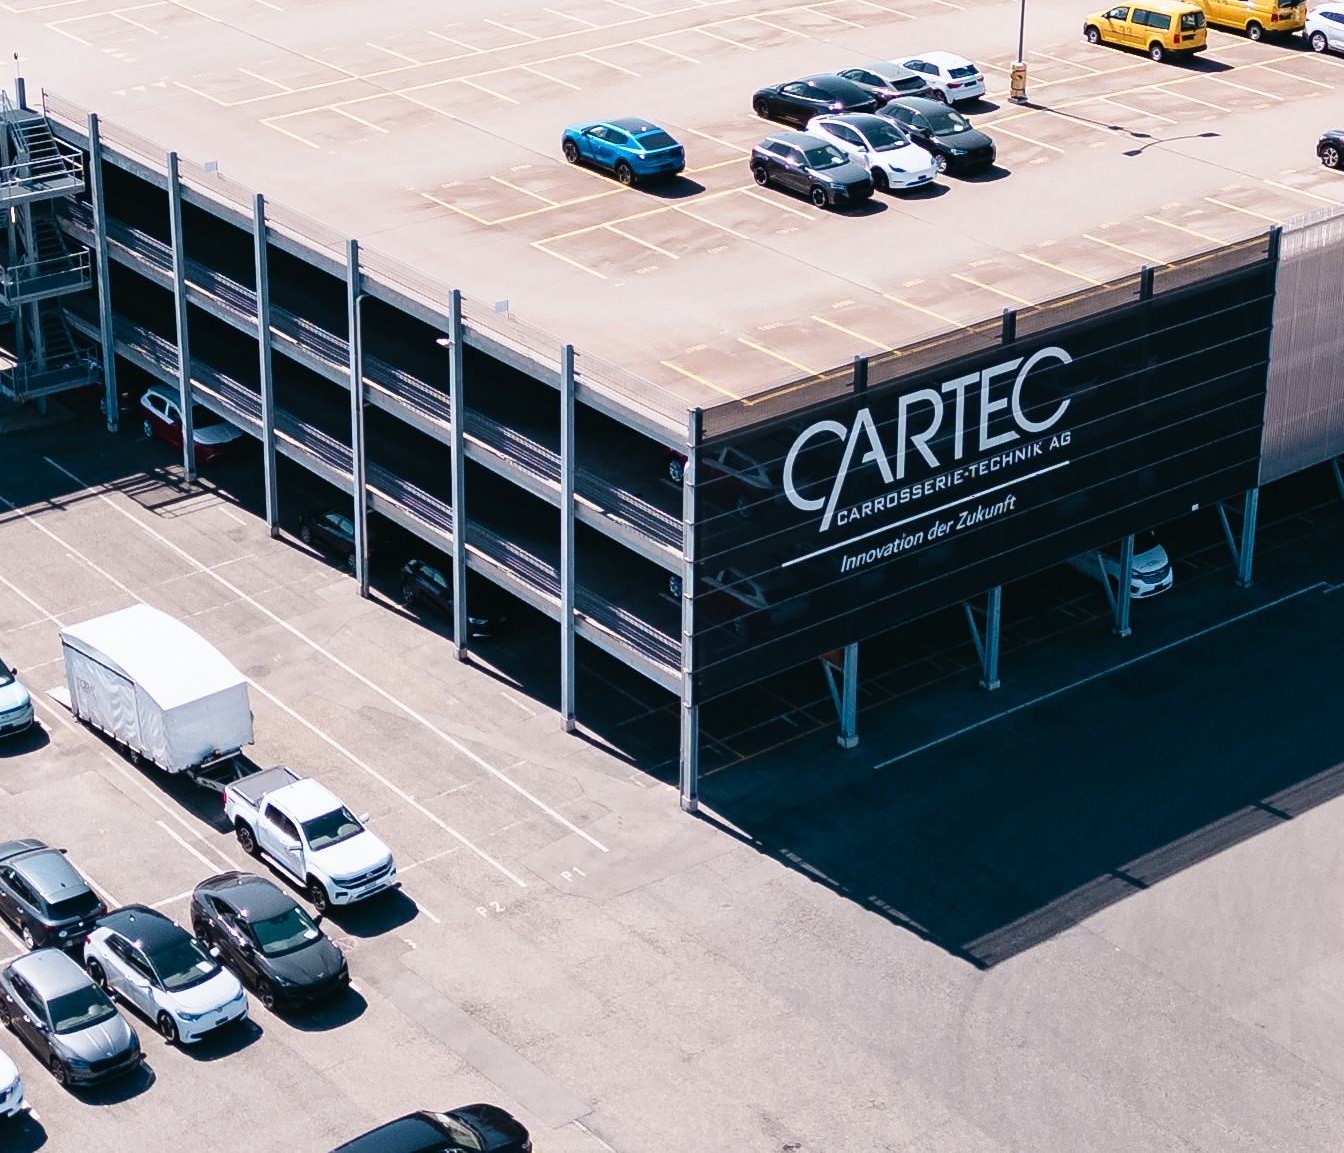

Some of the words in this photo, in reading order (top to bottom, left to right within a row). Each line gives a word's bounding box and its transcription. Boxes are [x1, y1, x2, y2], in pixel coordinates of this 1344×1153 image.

[782, 346, 1073, 533] CARTEC
[836, 441, 1043, 527] CARROSSERIE-TECHNIK
[1049, 431, 1072, 452] AG
[840, 532, 924, 574] Innovation
[927, 519, 954, 542] der
[956, 494, 1017, 530] Zukunft
